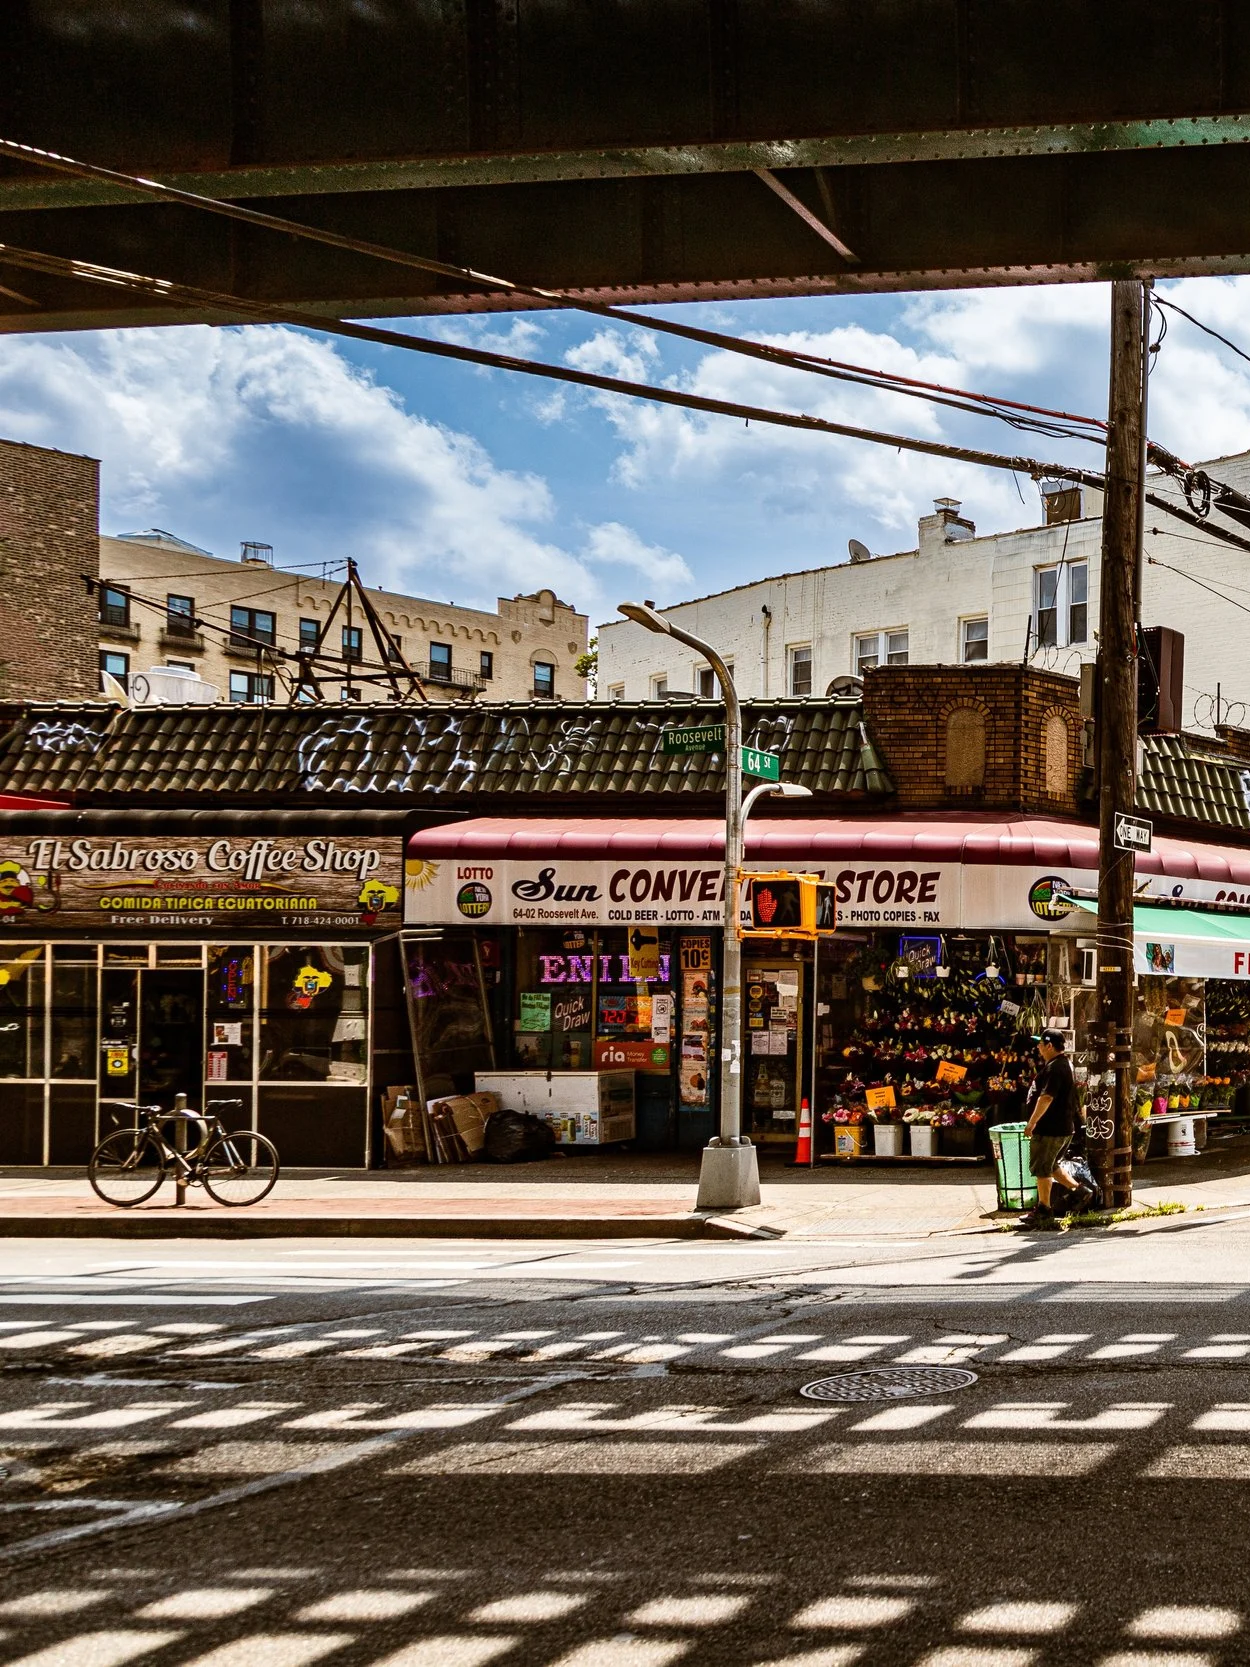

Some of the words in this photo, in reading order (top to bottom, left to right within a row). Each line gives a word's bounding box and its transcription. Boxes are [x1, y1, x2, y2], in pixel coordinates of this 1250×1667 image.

[668, 727, 722, 745] Roosevelt
[685, 743, 706, 752] Avenue
[748, 752, 761, 772] 64
[764, 756, 771, 769] St
[1119, 825, 1131, 839] ONE
[1135, 829, 1148, 843] WAY
[28, 839, 63, 870] El
[68, 839, 201, 871] Sabroso
[208, 840, 299, 880] Coffee
[303, 840, 381, 880] Shop
[457, 867, 493, 880] LOTTO
[511, 867, 604, 903] Sun
[836, 870, 941, 904] STORE
[1052, 880, 1066, 889] NE
[100, 897, 163, 909] COMIDA
[166, 897, 213, 910] TIPICA
[217, 897, 318, 910] ECUATORIANA
[513, 908, 536, 919] 64-02
[538, 908, 580, 919] Roosevelt
[581, 908, 599, 919] Ave.
[608, 910, 633, 921] COLD
[635, 910, 658, 921] BEER
[666, 910, 695, 921] LOTTO
[702, 911, 720, 921] ATM
[851, 911, 881, 921] PHOTO
[884, 911, 917, 922] COPIES
[923, 912, 940, 922] FAX
[111, 915, 145, 924] Free
[150, 915, 214, 926] Delivery
[292, 916, 360, 925] 718-424-0001
[680, 939, 710, 949] COPIES
[908, 946, 931, 963] Quick
[554, 995, 585, 1019] Quick
[563, 1010, 591, 1032] Draw
[601, 1046, 625, 1063] ria
[627, 1051, 645, 1059] Money
